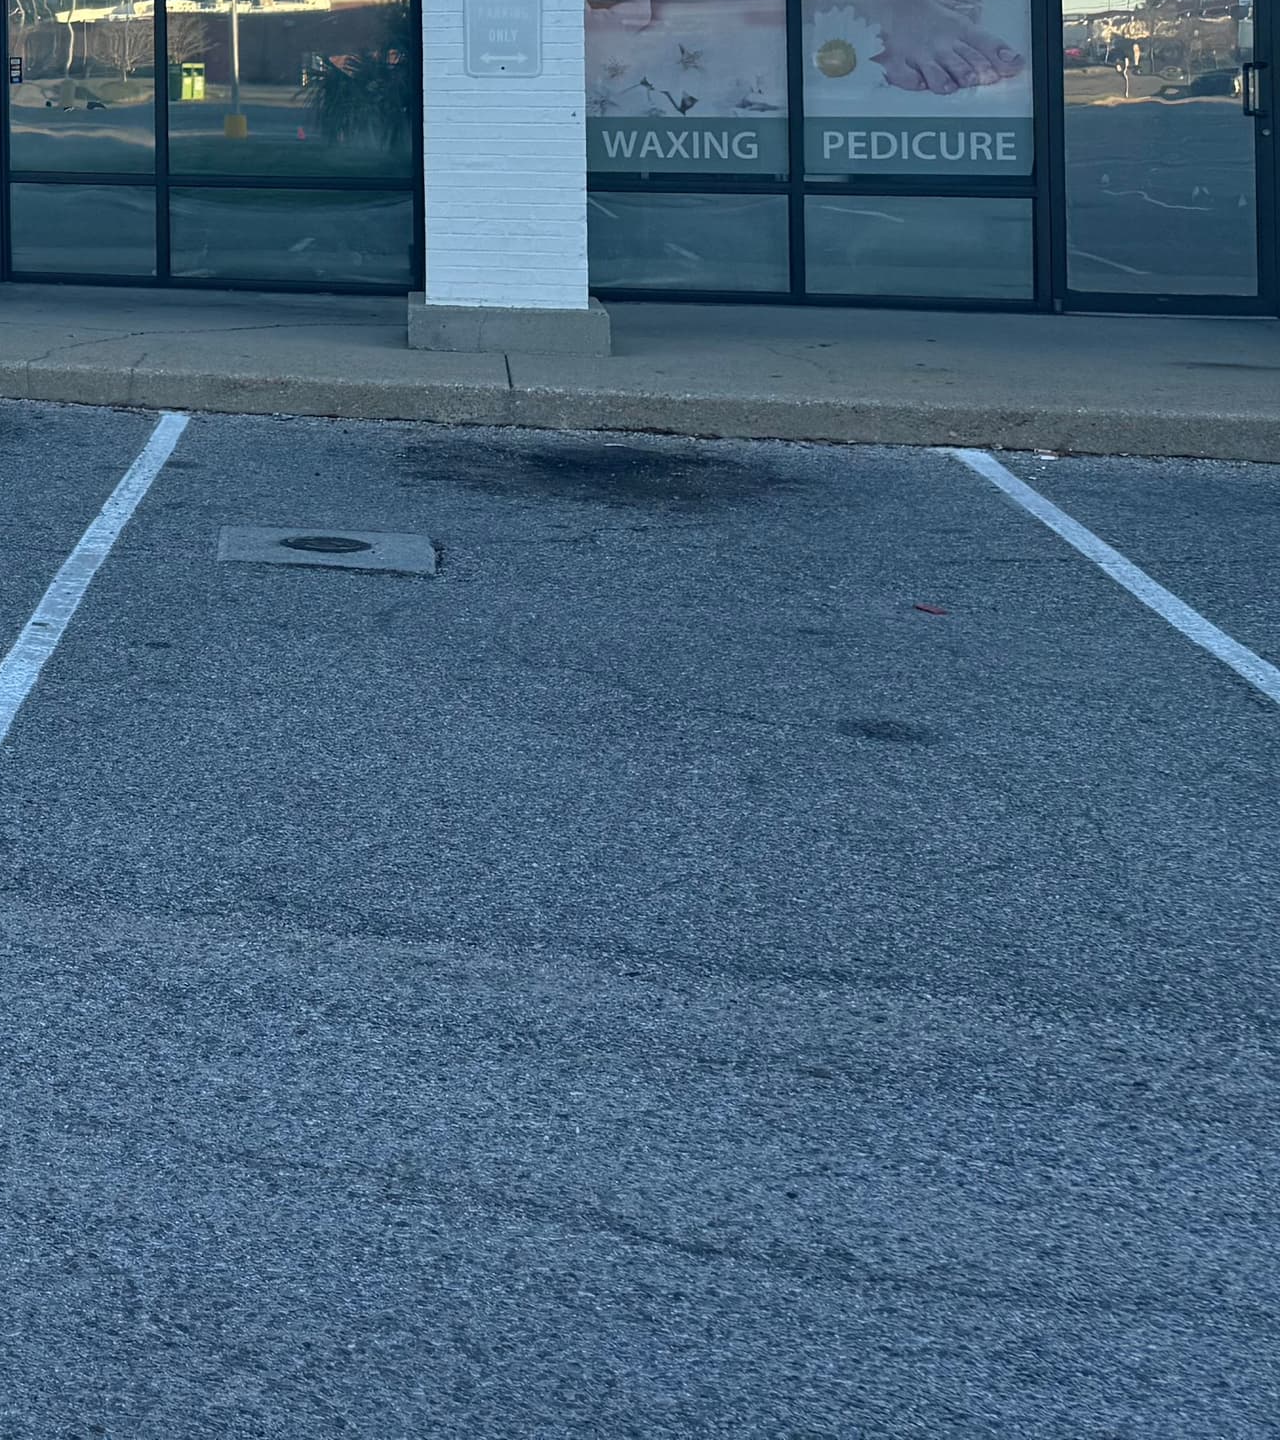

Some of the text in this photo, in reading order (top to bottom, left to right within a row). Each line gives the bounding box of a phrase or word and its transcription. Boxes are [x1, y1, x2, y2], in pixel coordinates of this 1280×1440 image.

[488, 28, 520, 43] ONLY
[602, 130, 759, 160] WAXING
[823, 131, 1017, 161] PEDICURE
